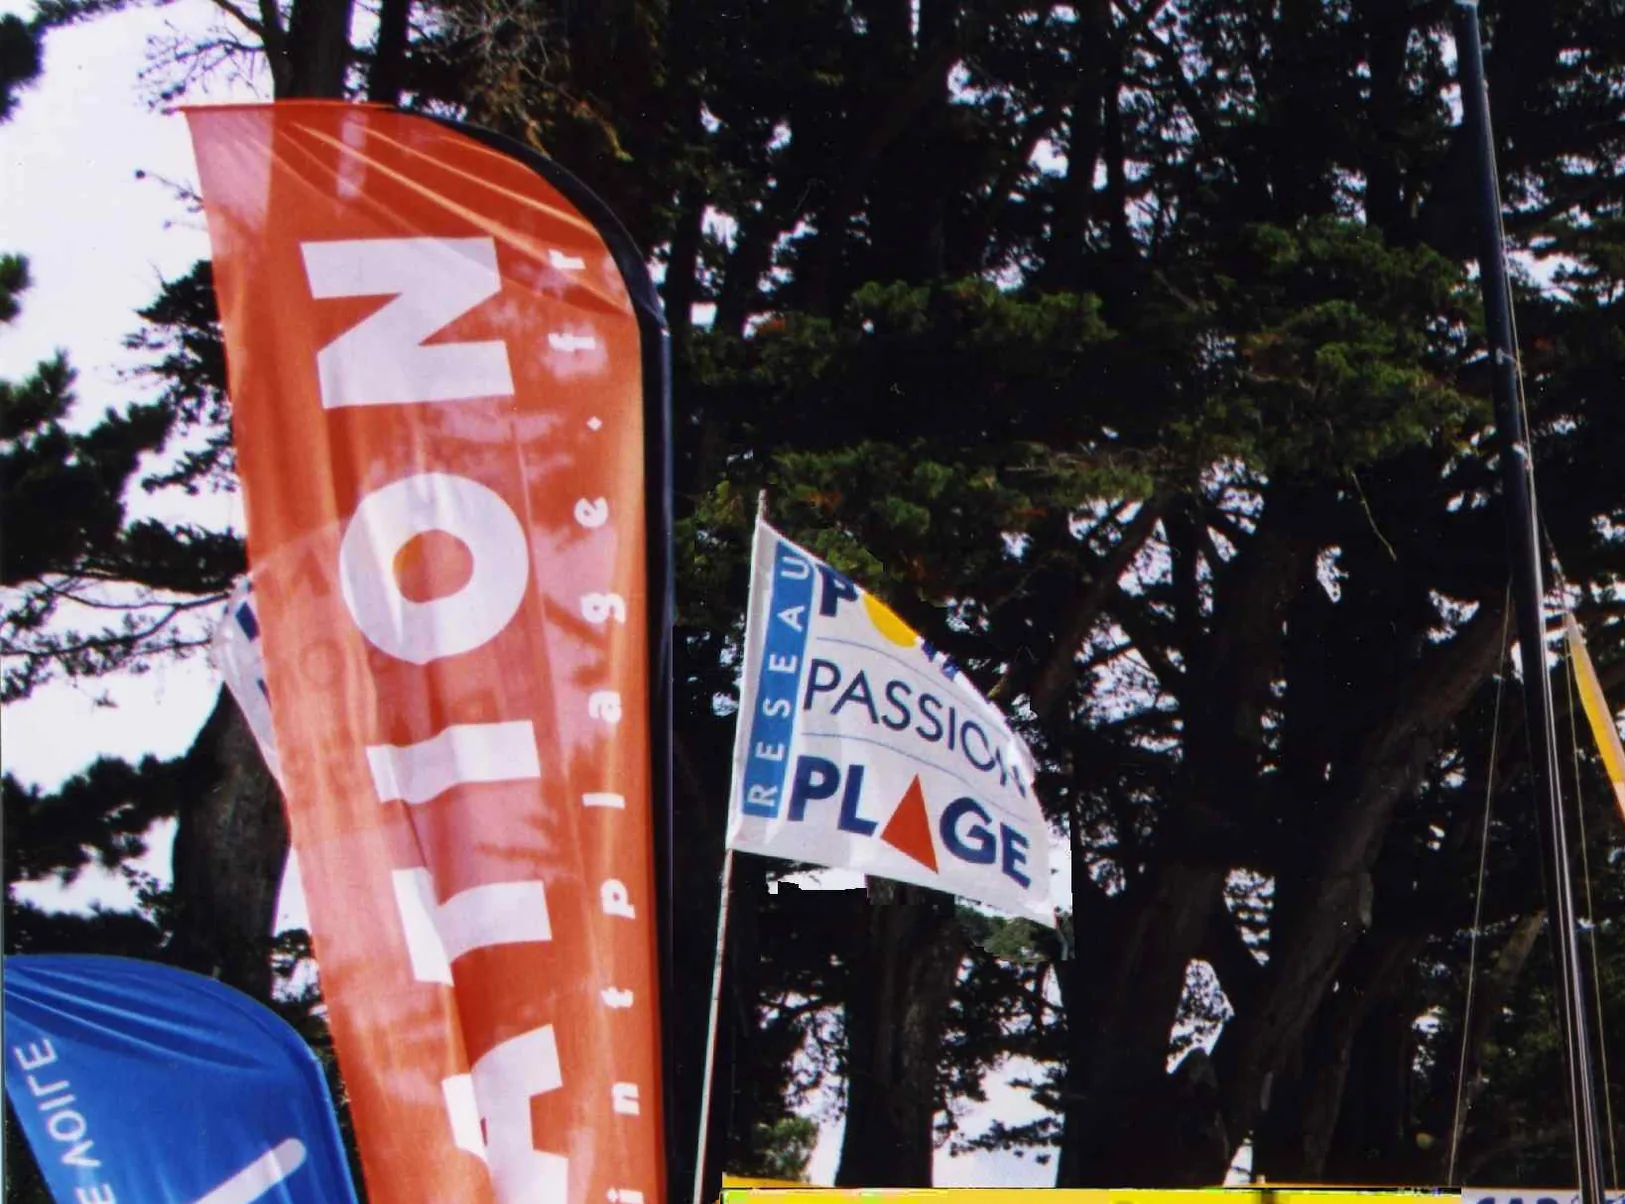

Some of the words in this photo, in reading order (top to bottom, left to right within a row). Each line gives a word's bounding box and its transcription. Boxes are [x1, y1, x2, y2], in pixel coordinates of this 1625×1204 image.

[747, 553, 811, 809] RESEAU
[802, 658, 1028, 799] PASSION
[787, 754, 1032, 890] PLAGE
